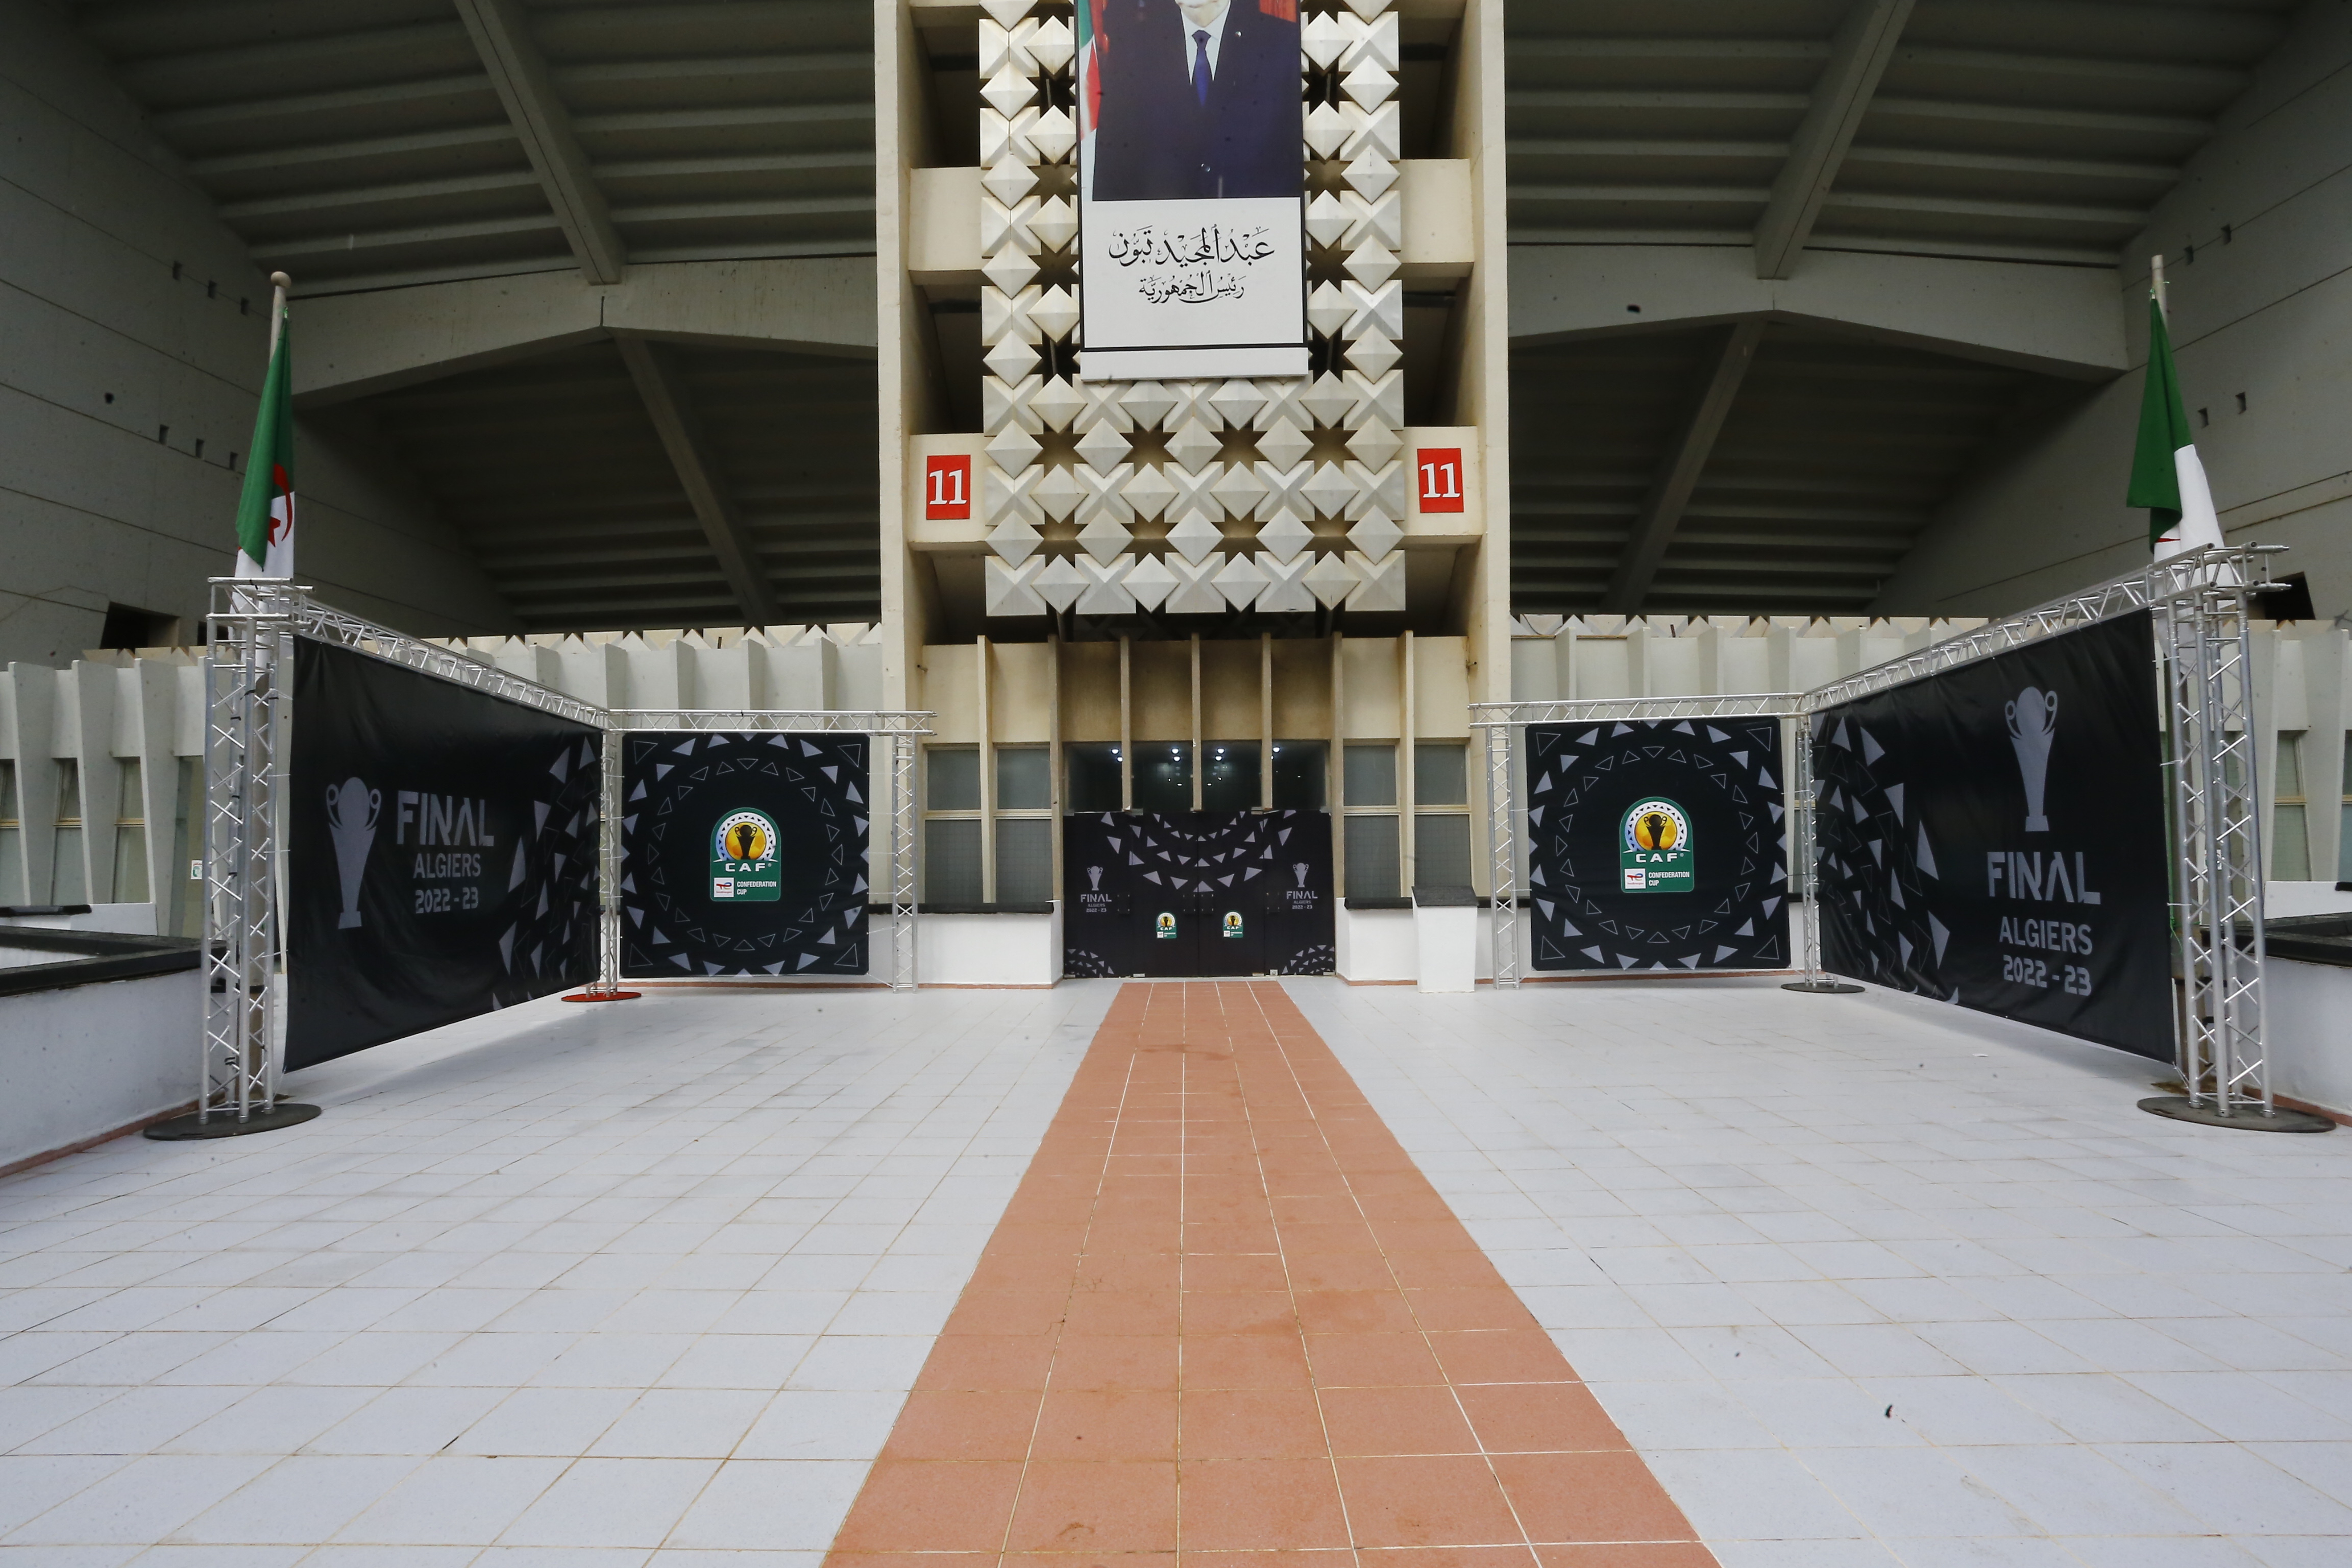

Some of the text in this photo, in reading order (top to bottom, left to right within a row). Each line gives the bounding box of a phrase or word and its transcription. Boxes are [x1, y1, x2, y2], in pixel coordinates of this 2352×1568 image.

[929, 469, 967, 505] 11
[1420, 462, 1461, 498] 11
[397, 790, 494, 846] FINAL
[413, 852, 481, 878] ALGIERS
[725, 863, 766, 872] CAF
[1635, 853, 1678, 863] CAF
[1987, 851, 2101, 904] FINAL
[415, 888, 451, 914] 2022
[462, 887, 479, 910] 23
[1081, 894, 1112, 902] FINAL
[1286, 891, 1318, 899] FINAL
[1999, 916, 2093, 955] ALGIERS
[2003, 954, 2047, 988] 2022
[2064, 964, 2092, 996] 23
